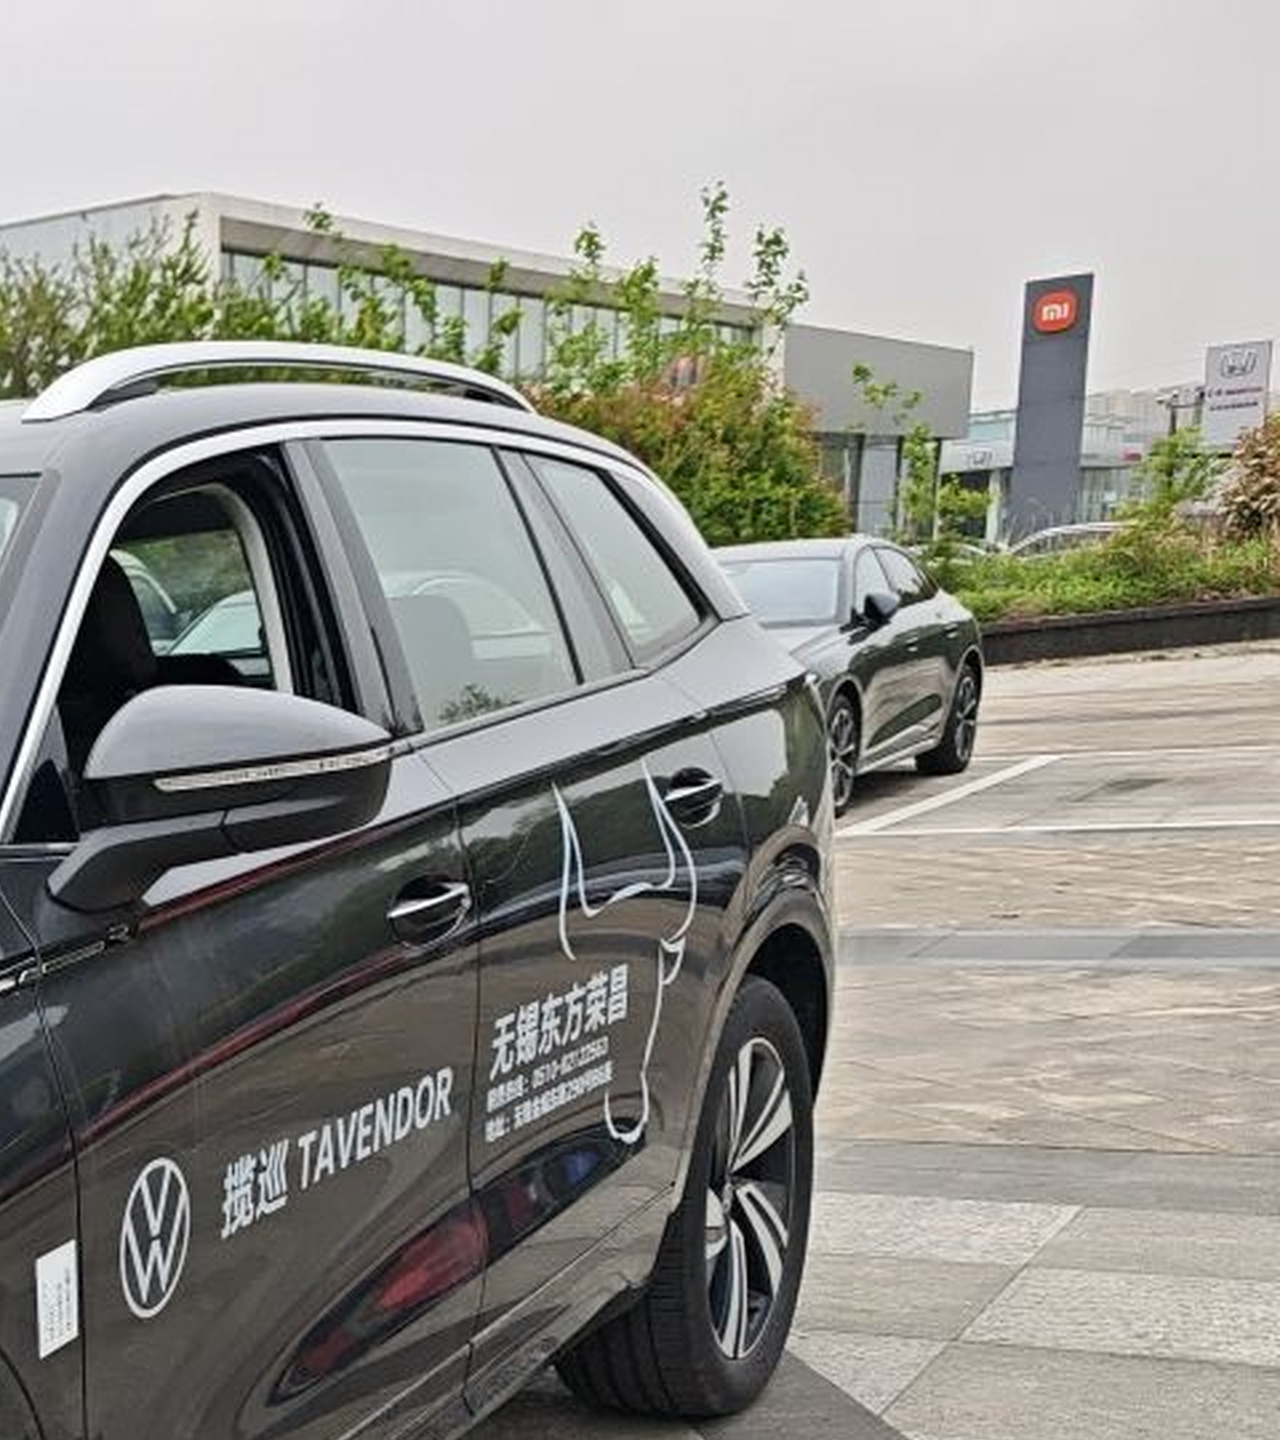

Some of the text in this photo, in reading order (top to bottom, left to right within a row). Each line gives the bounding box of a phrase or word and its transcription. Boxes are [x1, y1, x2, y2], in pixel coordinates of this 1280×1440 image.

[490, 964, 629, 1081] 无锡东方荣昌
[222, 1067, 453, 1239] 揽巡 TAVENDOR
